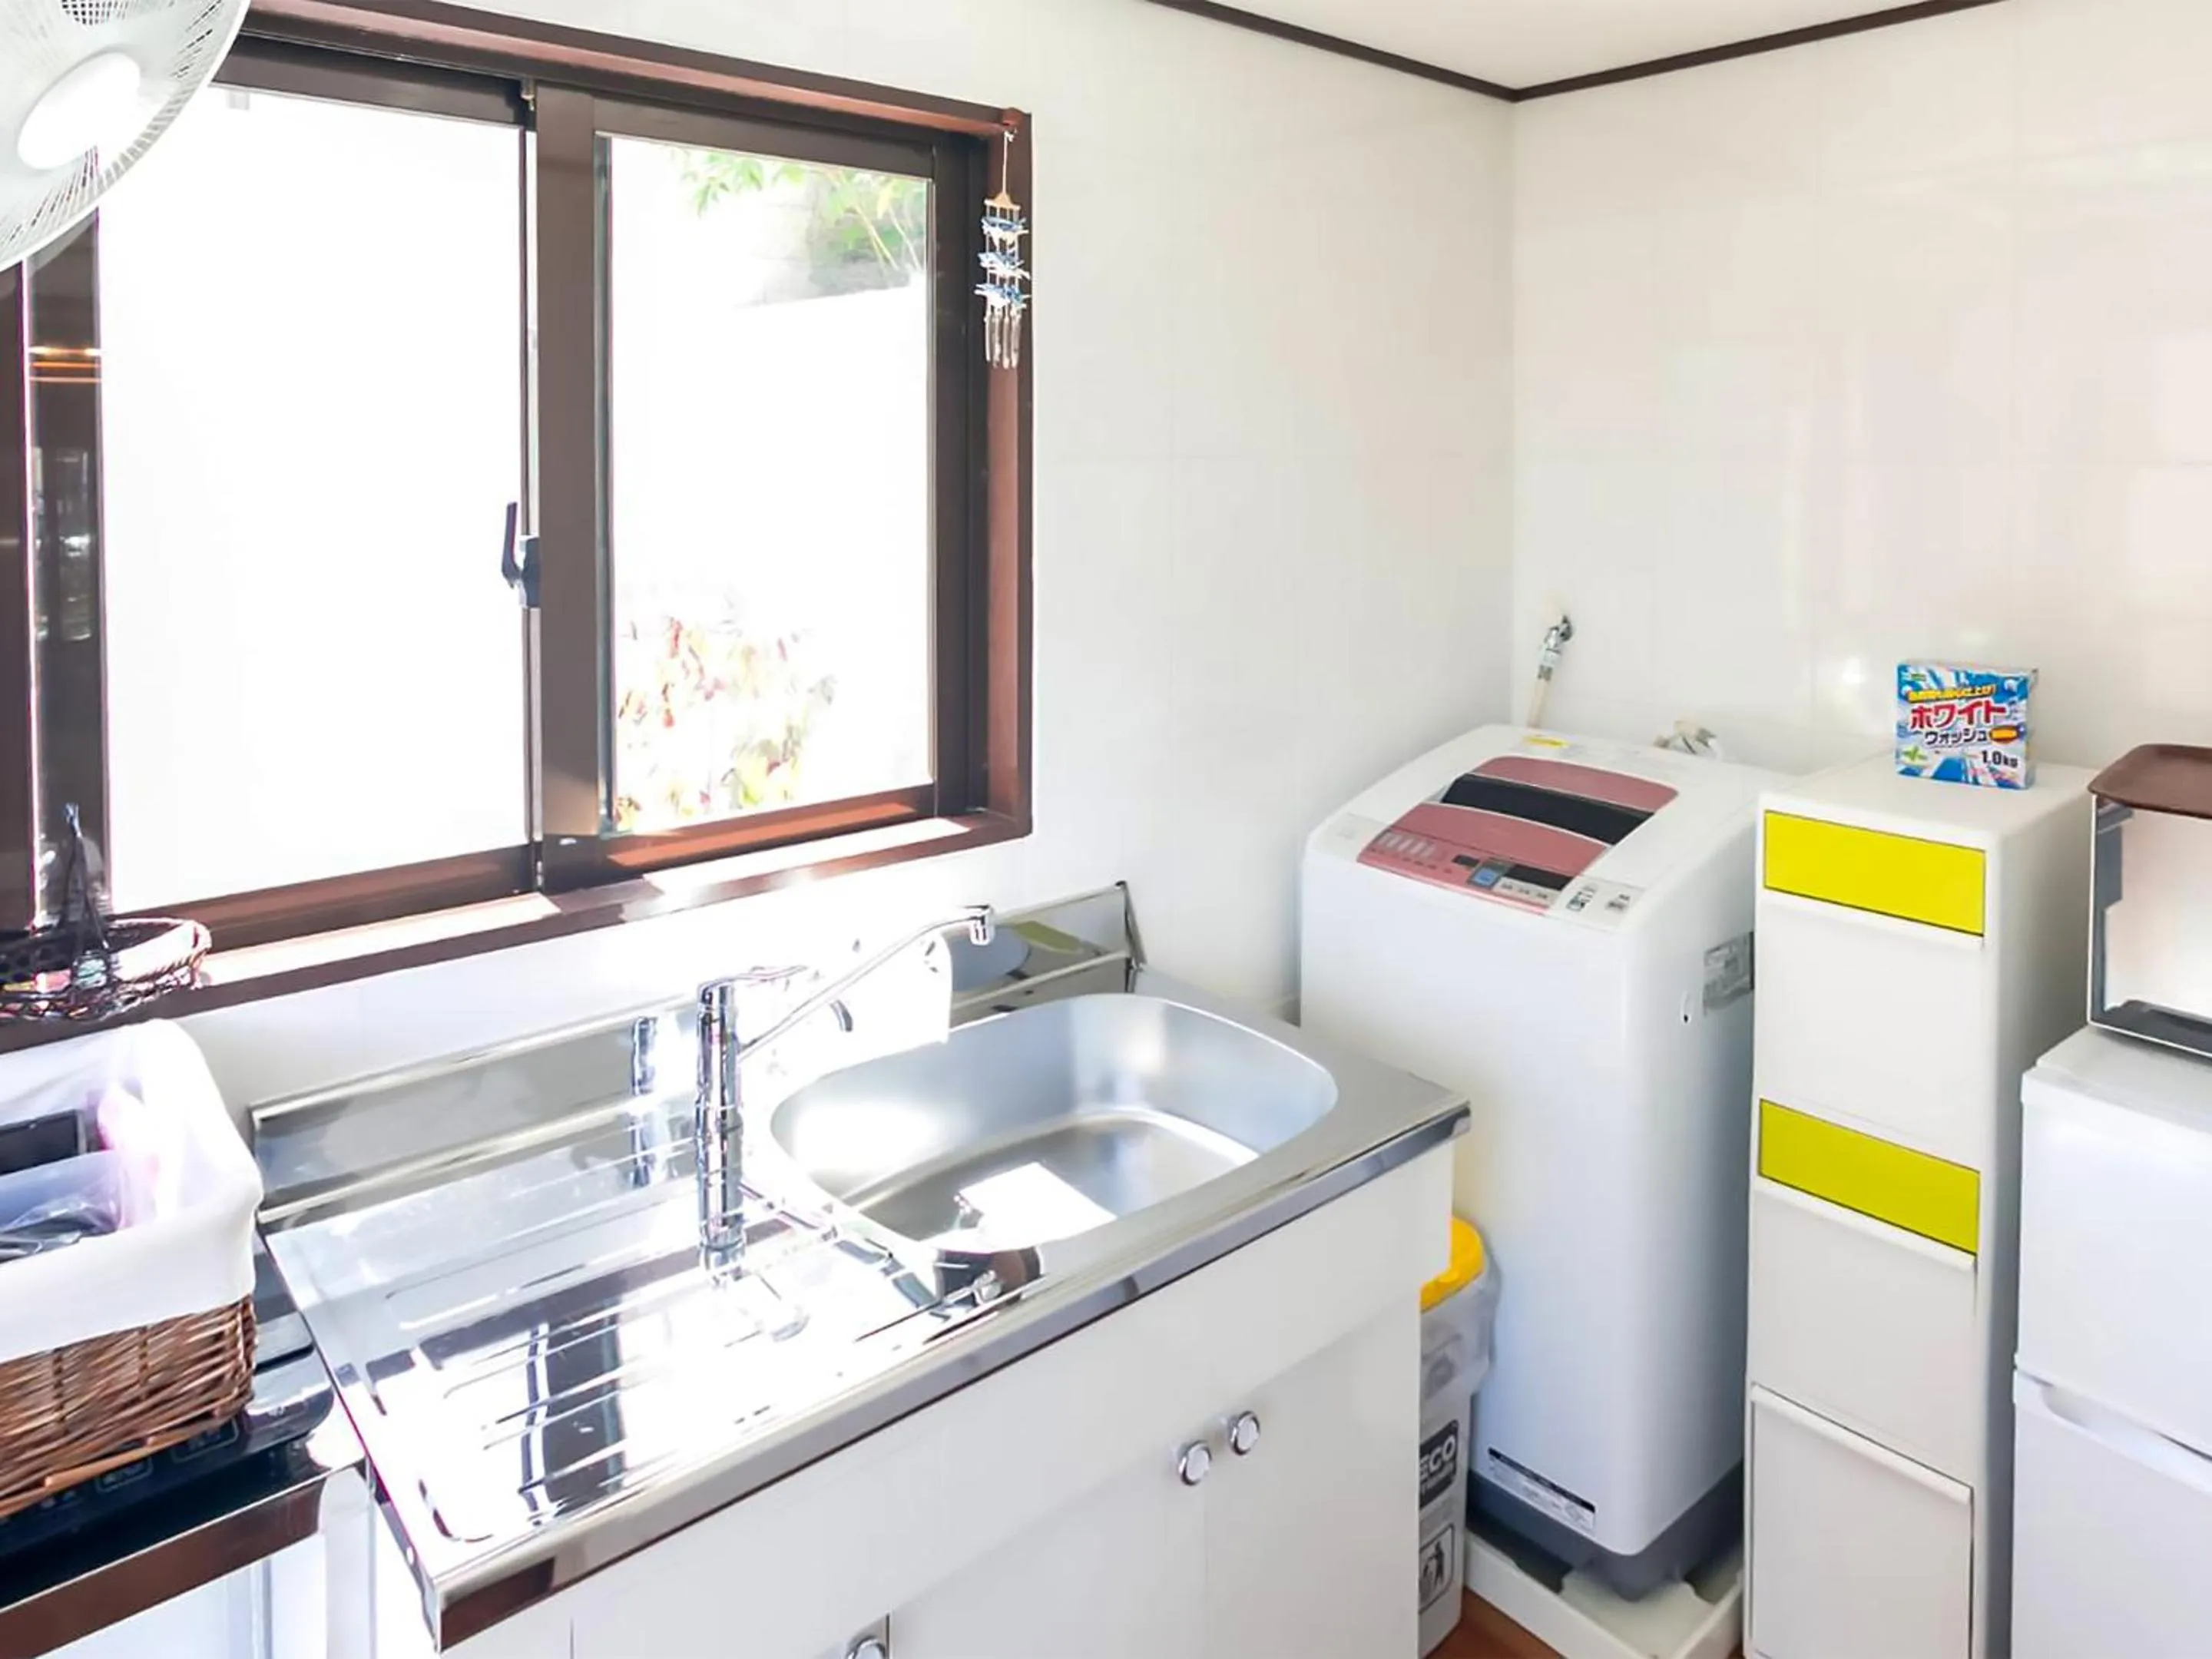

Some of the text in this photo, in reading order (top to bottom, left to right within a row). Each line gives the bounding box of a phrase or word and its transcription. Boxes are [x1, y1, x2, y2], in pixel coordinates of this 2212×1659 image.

[1910, 700, 2007, 730] ホワイト
[1925, 729, 1988, 745] ウォッシュ
